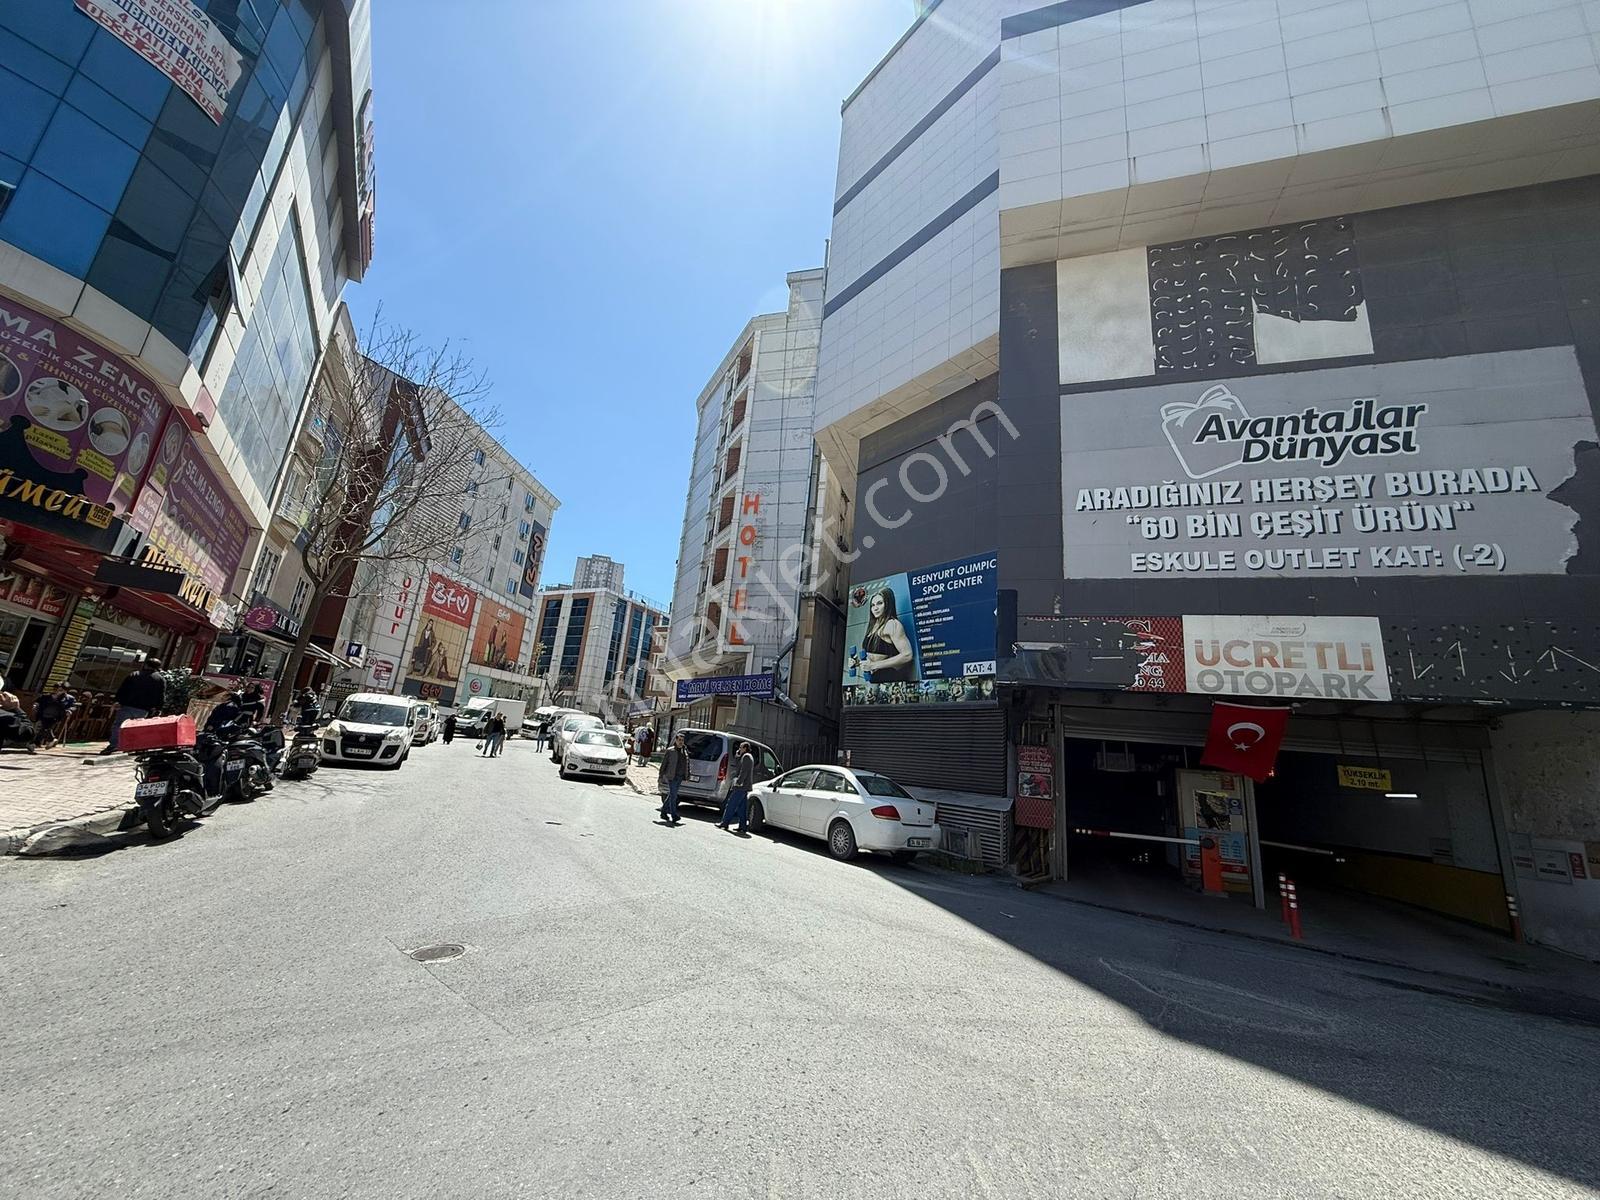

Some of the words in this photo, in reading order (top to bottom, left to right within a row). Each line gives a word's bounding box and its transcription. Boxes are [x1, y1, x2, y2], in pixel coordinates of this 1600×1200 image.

[86, 3, 138, 45] 0533
[141, 46, 174, 74] 278
[150, 7, 194, 45] SÜRÜCÜ
[118, 12, 130, 24] 4
[175, 57, 204, 93] BİNA
[63, 359, 108, 388] SALONU
[73, 345, 162, 418] ZENGİN
[1195, 399, 1426, 443] Avantajlar
[1242, 429, 1418, 467] Dünyası
[185, 459, 208, 495] SELMA
[204, 485, 226, 520] ZENGİN
[1076, 479, 1243, 511] ARADIĞINIZ
[1250, 473, 1376, 503] HERŞEY
[1385, 466, 1541, 497] BURADA
[1186, 510, 1242, 538] BİN
[1250, 505, 1342, 540] ÇEŞİT
[729, 493, 761, 646] HOTEL
[912, 568, 955, 586] ESENYURT
[957, 558, 997, 576] OLIMPIC
[1131, 550, 1237, 572] ESKULE
[1244, 547, 1359, 570] OUTLET
[1370, 545, 1444, 569] KAT:
[1453, 543, 1506, 571] (-2)
[922, 580, 945, 596] SPOR
[947, 575, 983, 591] CENTER
[966, 663, 985, 674] KAT:
[987, 662, 993, 673] 4
[1194, 639, 1375, 672] ÜCRETLİ
[744, 676, 773, 690] HOME
[1196, 668, 1379, 700] OTOPARK
